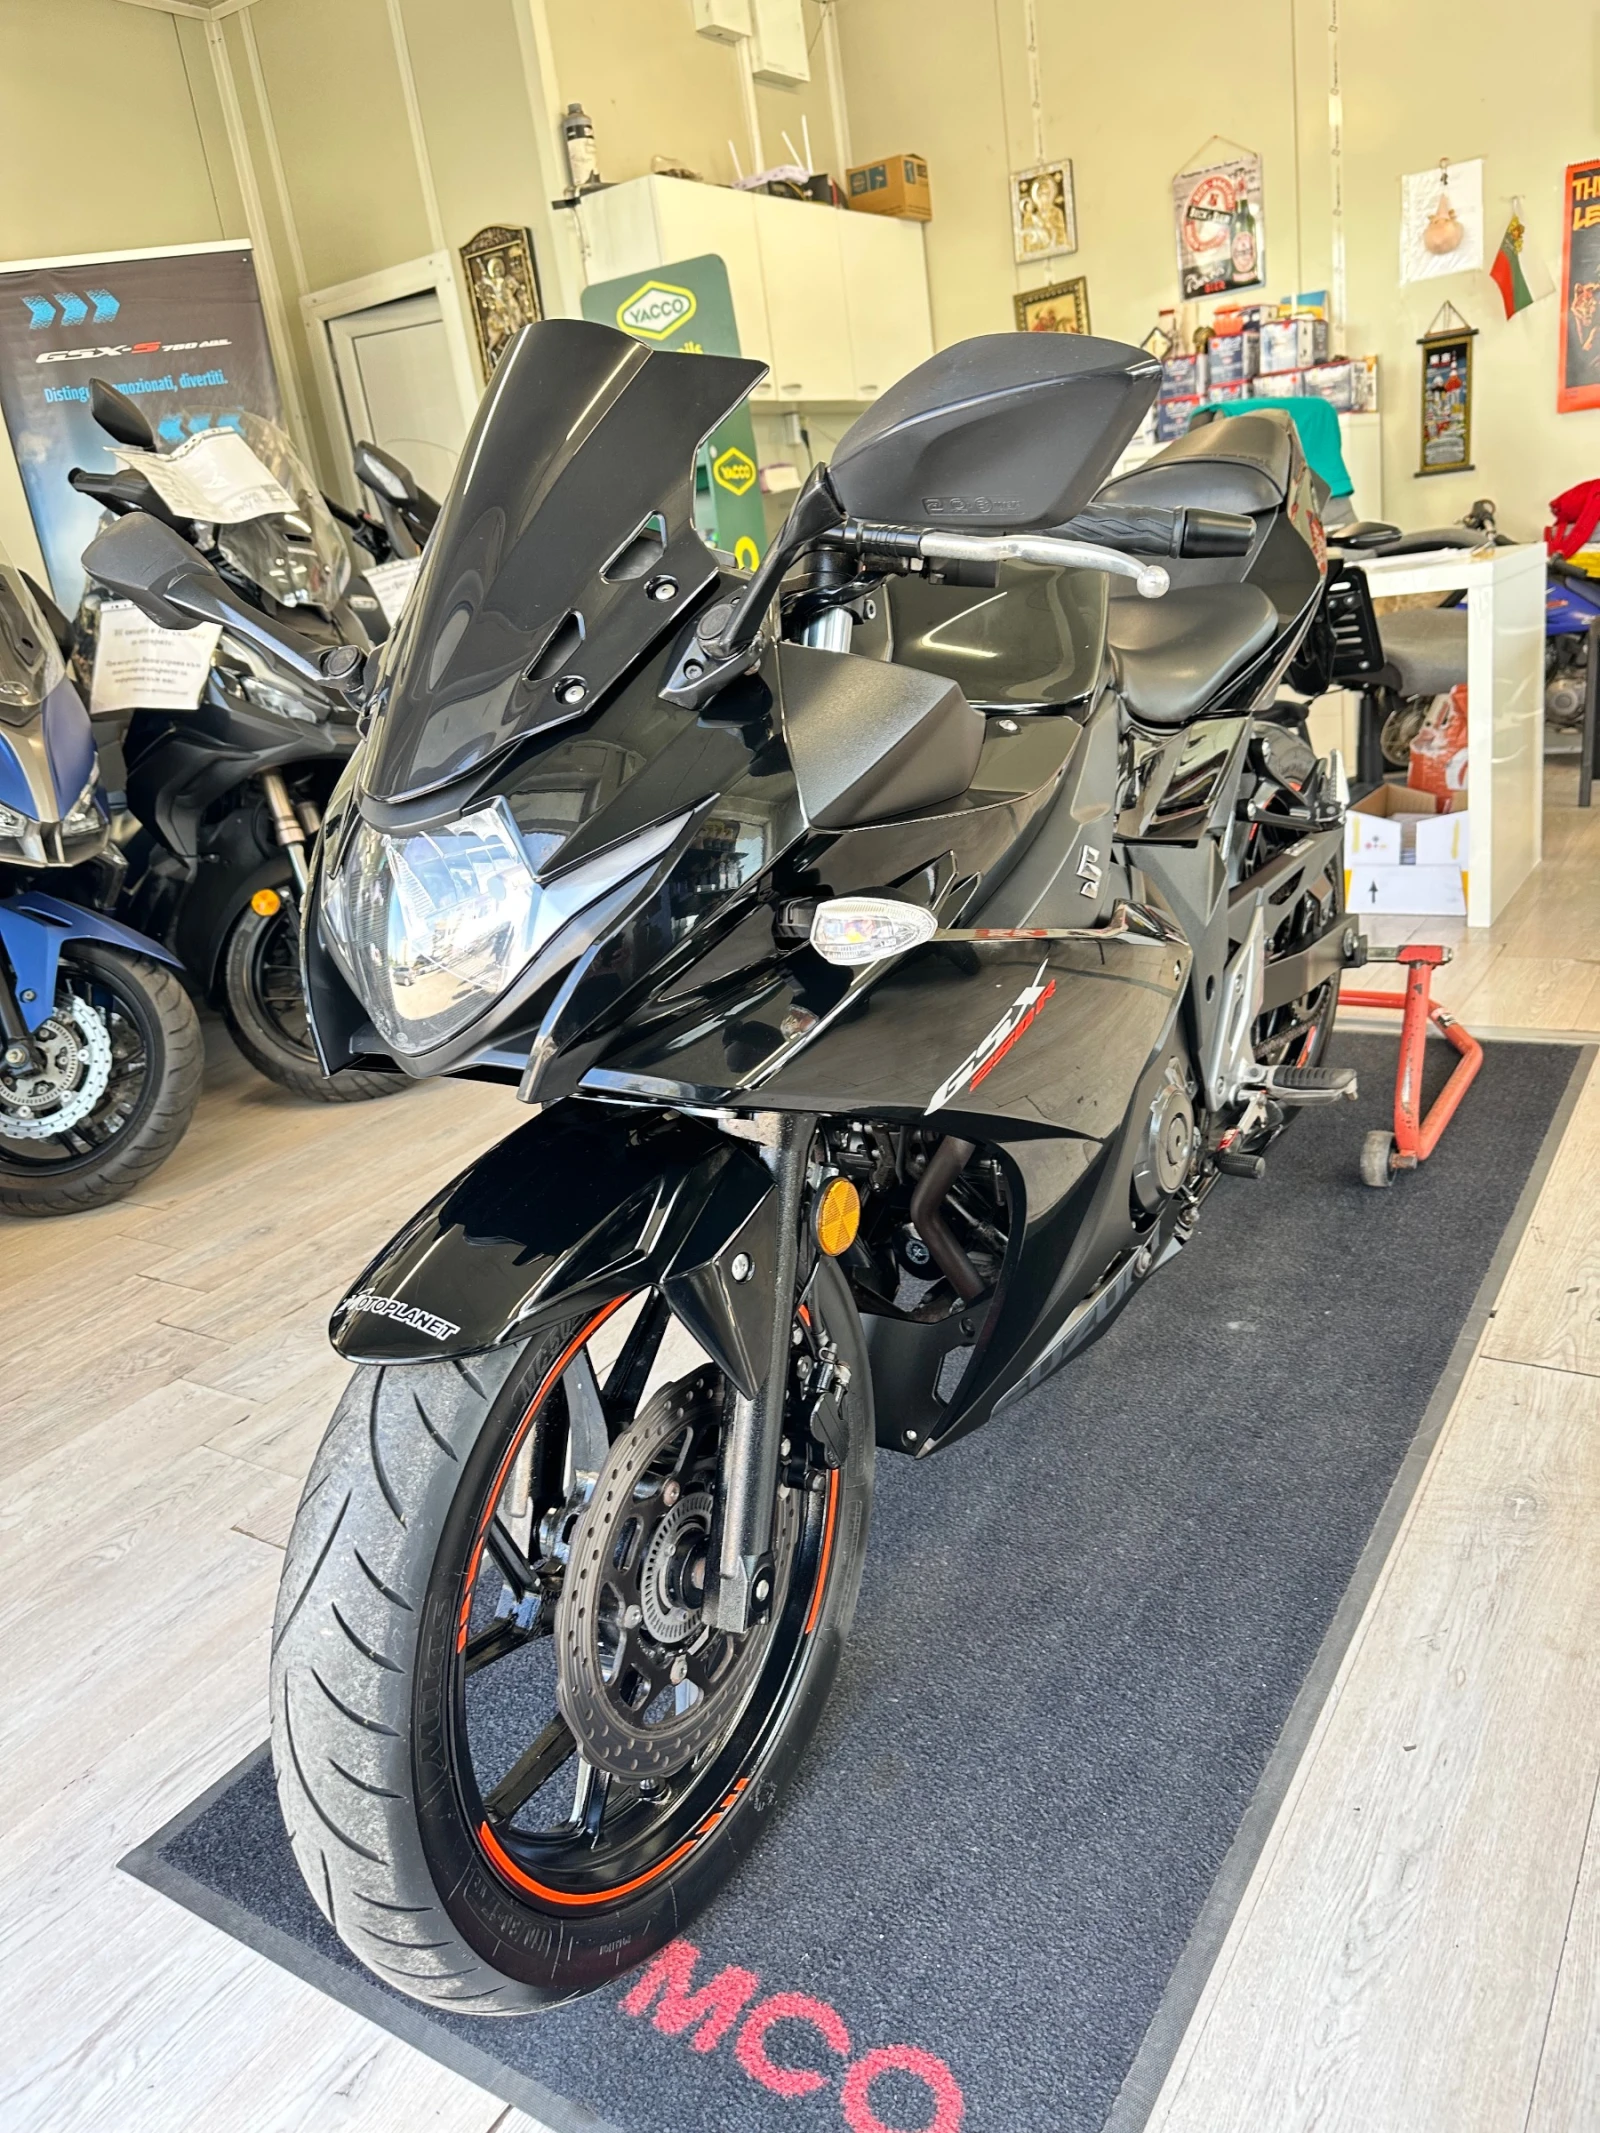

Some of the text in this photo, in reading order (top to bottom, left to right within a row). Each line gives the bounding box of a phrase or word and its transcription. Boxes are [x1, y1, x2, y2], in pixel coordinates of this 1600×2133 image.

[630, 298, 684, 323] YACCO
[36, 341, 161, 364] GSX-S
[180, 369, 228, 389] divertiti.
[341, 1293, 461, 1341] MOTOPLANET
